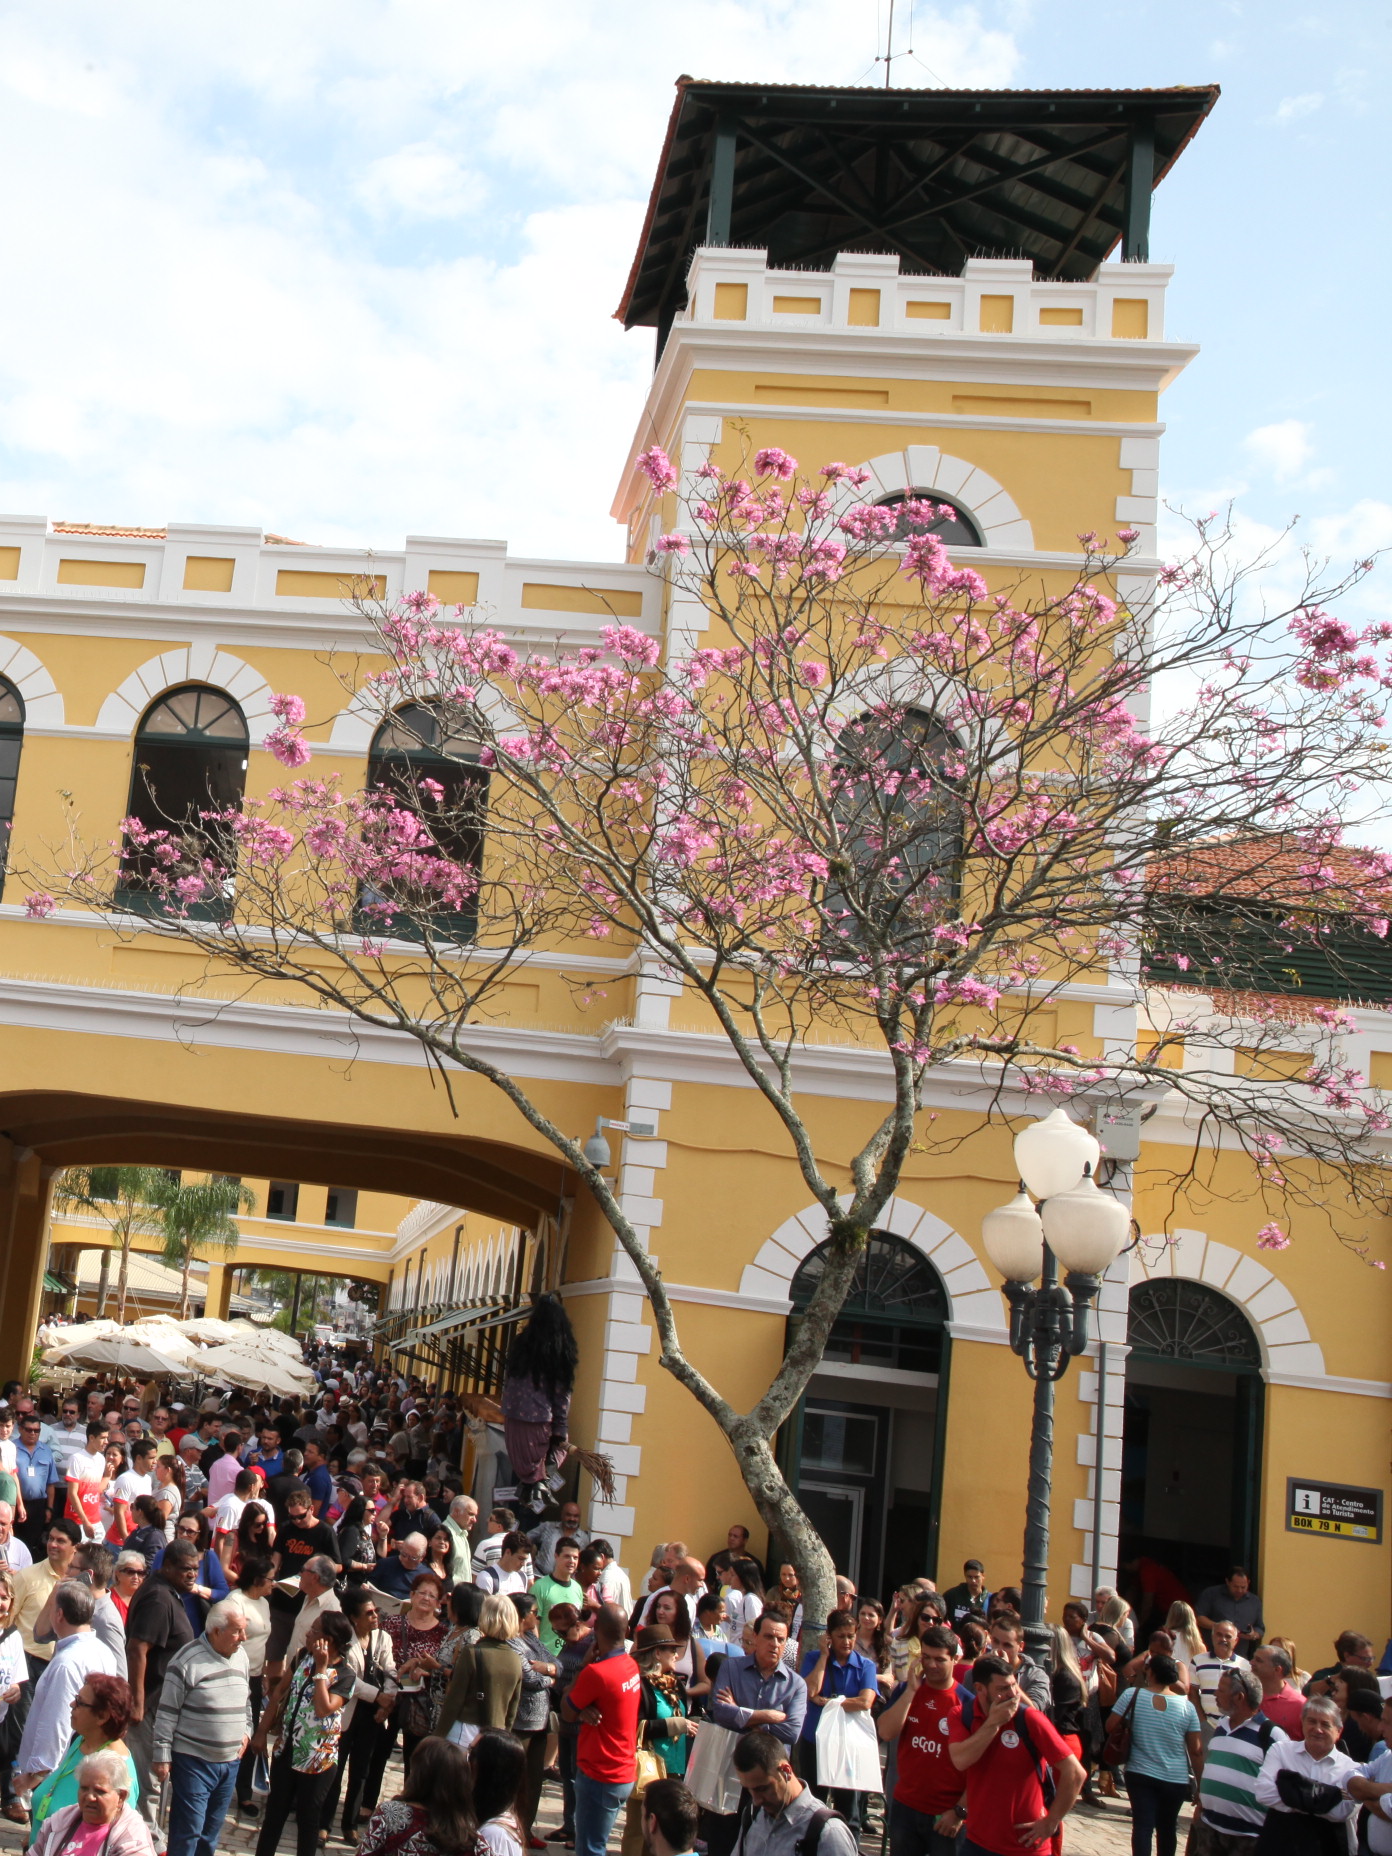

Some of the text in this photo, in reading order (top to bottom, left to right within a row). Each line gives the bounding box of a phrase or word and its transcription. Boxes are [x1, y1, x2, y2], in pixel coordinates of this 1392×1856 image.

[1341, 1499, 1364, 1508] Centro
[1332, 1504, 1375, 1515] Atendimento
[1332, 1509, 1354, 1518] Turista
[1294, 1517, 1341, 1532] BOX 79 N
[285, 1538, 314, 1555] Vans
